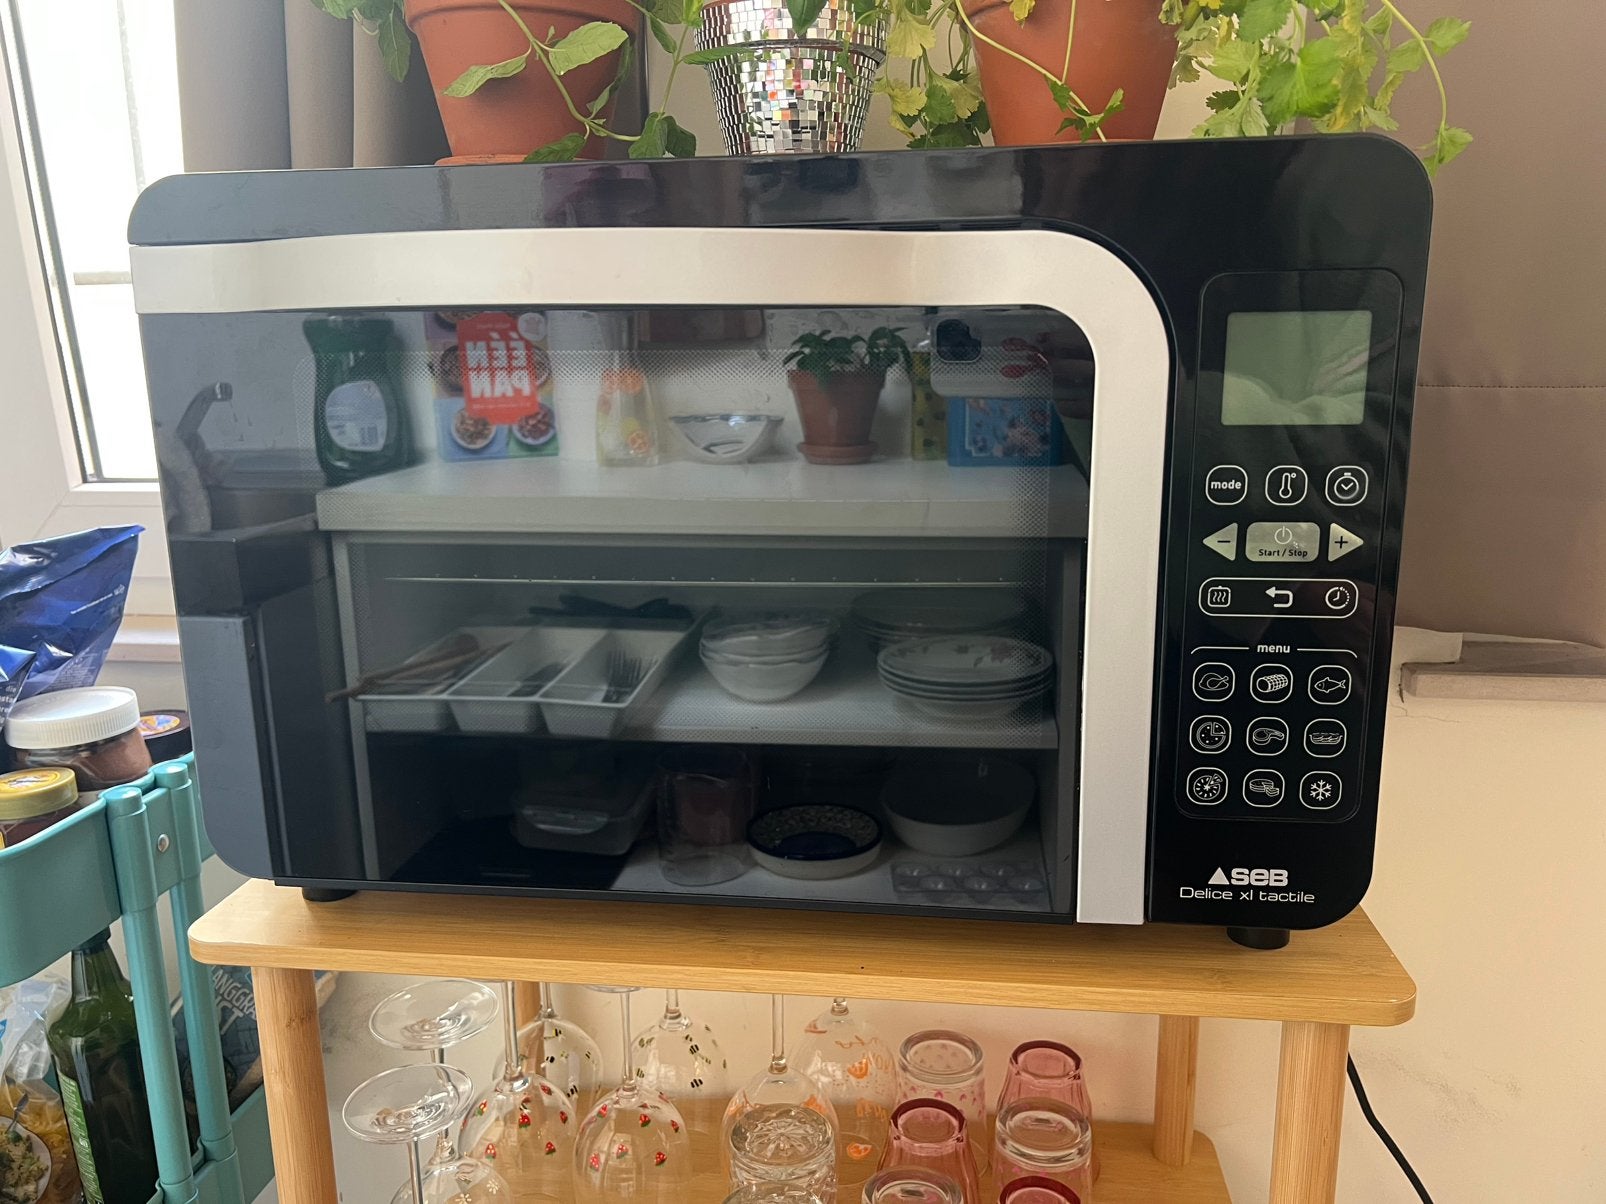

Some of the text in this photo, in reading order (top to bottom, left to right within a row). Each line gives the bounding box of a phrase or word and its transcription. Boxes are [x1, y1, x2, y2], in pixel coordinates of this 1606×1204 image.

[1210, 479, 1242, 490] mode
[1258, 548, 1280, 557] Start
[1288, 549, 1308, 558] Stop
[1256, 644, 1291, 653] menu
[1179, 886, 1315, 903] Delice xl tactile
